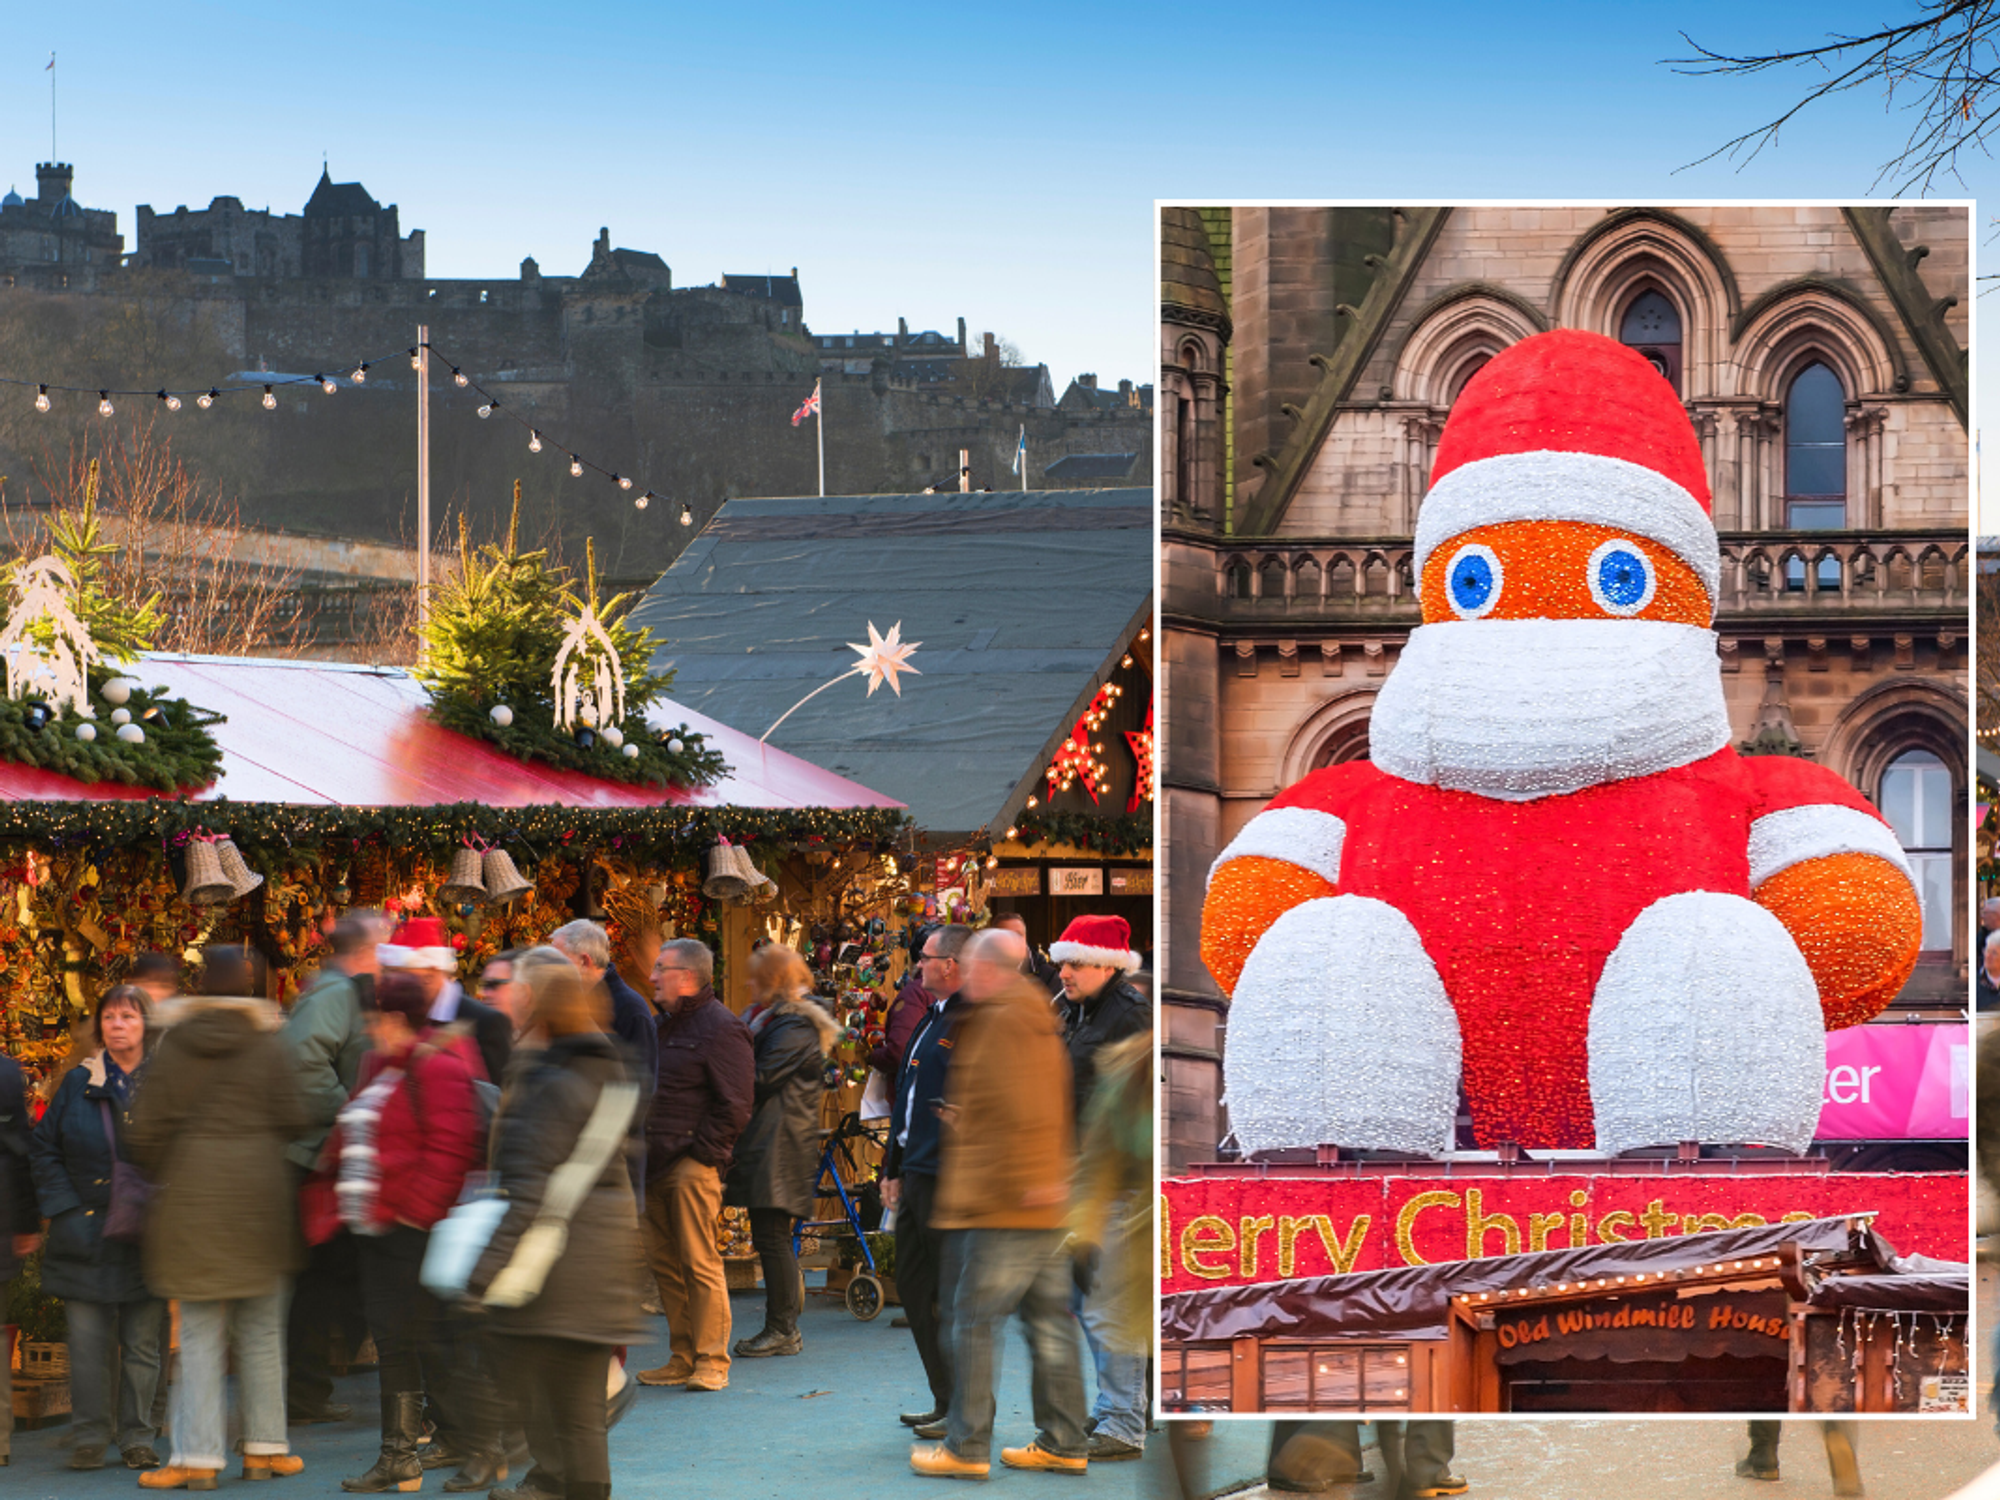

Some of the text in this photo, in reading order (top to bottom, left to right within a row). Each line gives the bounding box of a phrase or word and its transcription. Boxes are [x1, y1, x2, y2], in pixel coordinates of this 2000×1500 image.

[1396, 1188, 1816, 1265] Christ
[1499, 1315, 1550, 1349] Old
[1556, 1301, 1696, 1335] Windmill
